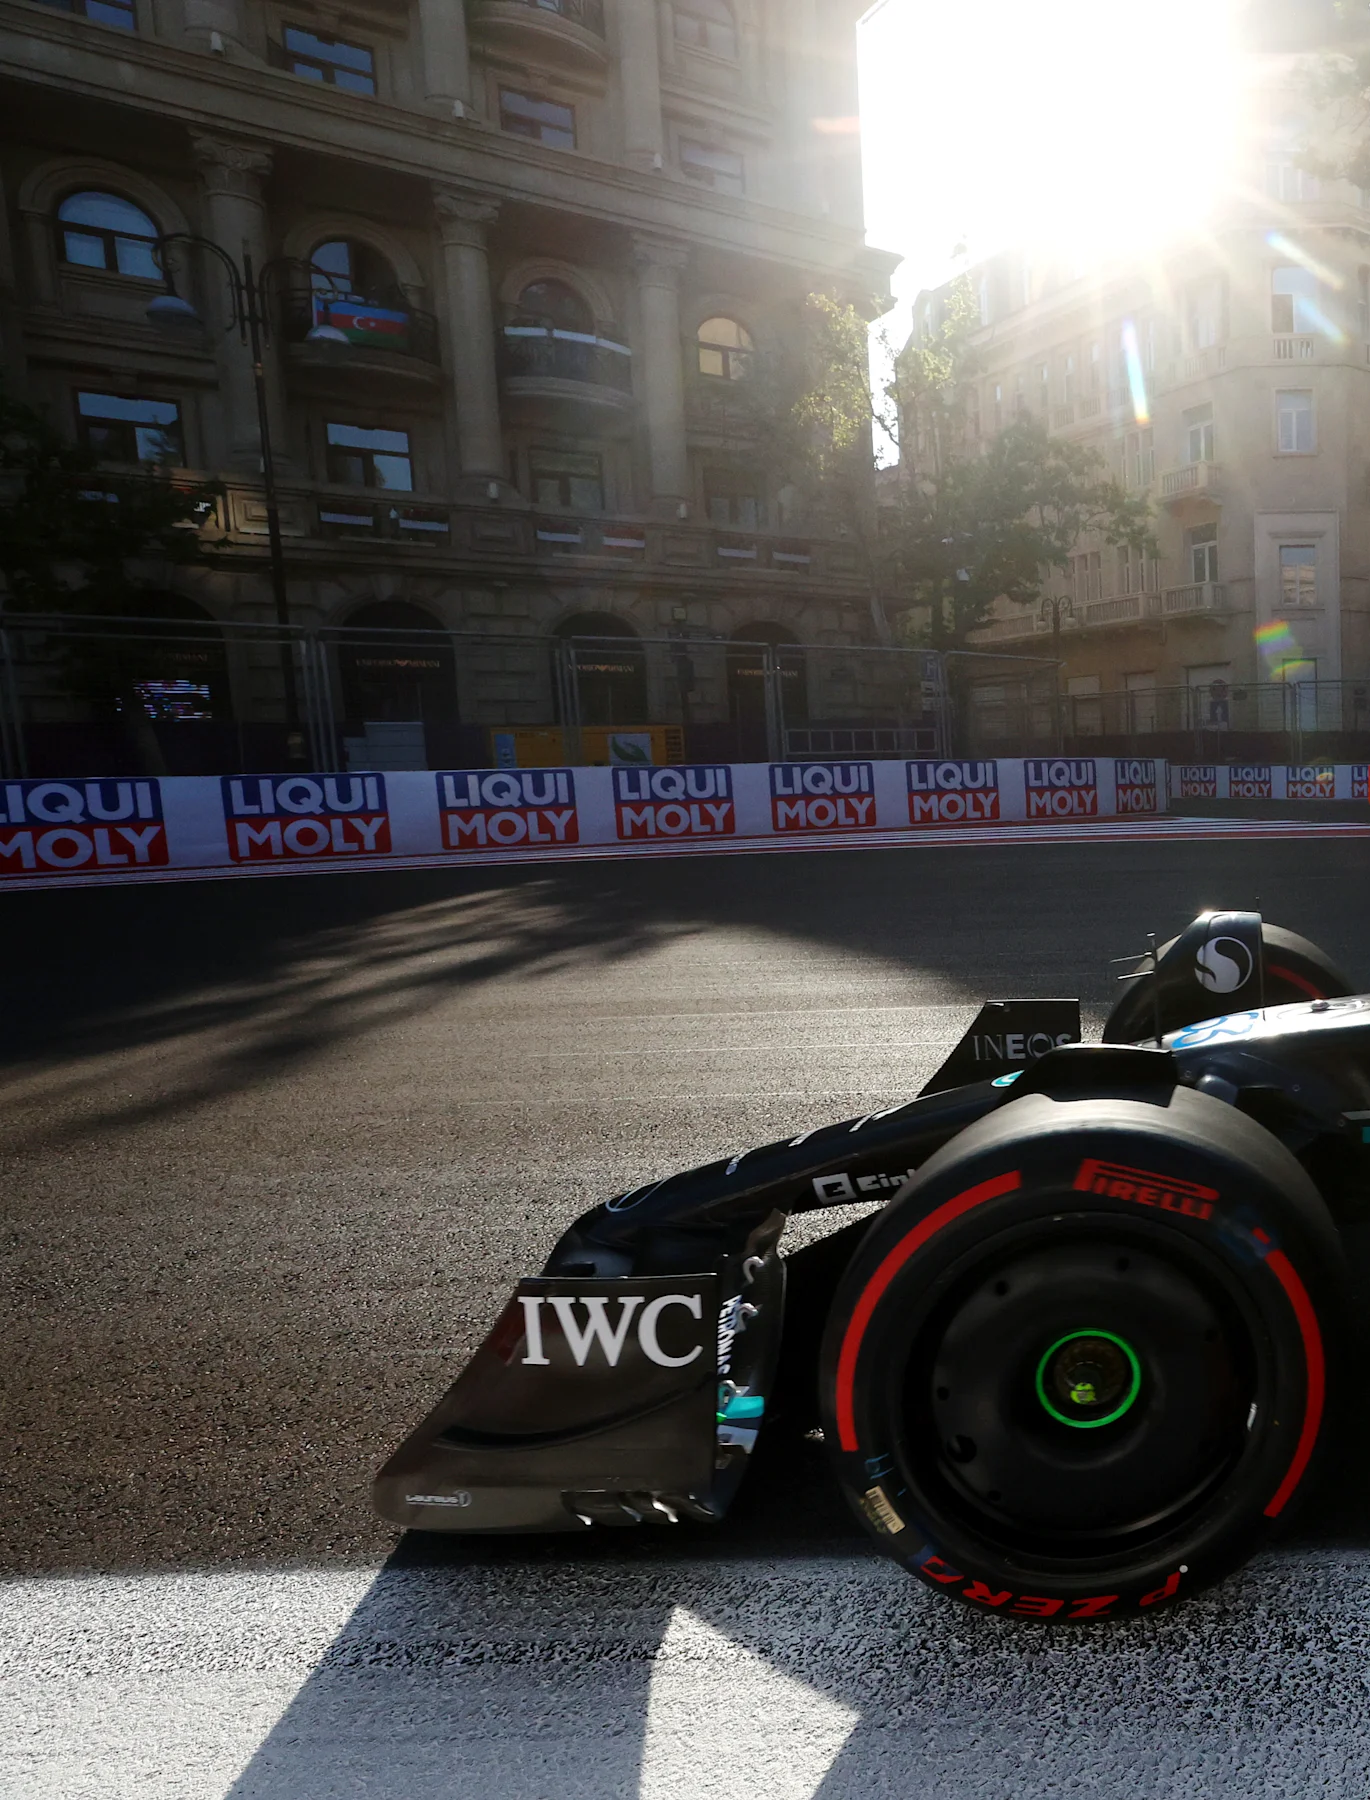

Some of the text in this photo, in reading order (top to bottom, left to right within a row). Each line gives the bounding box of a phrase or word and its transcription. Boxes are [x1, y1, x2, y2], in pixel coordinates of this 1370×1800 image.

[617, 768, 728, 801] LIQUI
[773, 764, 870, 796] LIQUI
[909, 761, 995, 790] LIQUI
[1026, 761, 1094, 788] LIQUI
[1116, 760, 1155, 785] LIQUI
[1181, 767, 1215, 781] LIQUI
[1230, 767, 1271, 781] LIQUI
[0, 782, 154, 824] IQUI
[229, 776, 381, 815] LIQUI
[443, 772, 570, 808] LIQUI
[1029, 789, 1097, 816] MOLY
[1118, 787, 1156, 813] MOLY
[1181, 782, 1216, 797] MOLY
[1231, 782, 1271, 798] MOLY
[1288, 782, 1335, 798] MOLY
[620, 803, 732, 837] MOLY
[777, 797, 874, 829] MOLY
[912, 791, 998, 821] MOLY
[234, 816, 386, 858] MOLY
[447, 809, 575, 846] MOLY
[1072, 1157, 1221, 1221] PIRELLI
[517, 1293, 704, 1369] IWC
